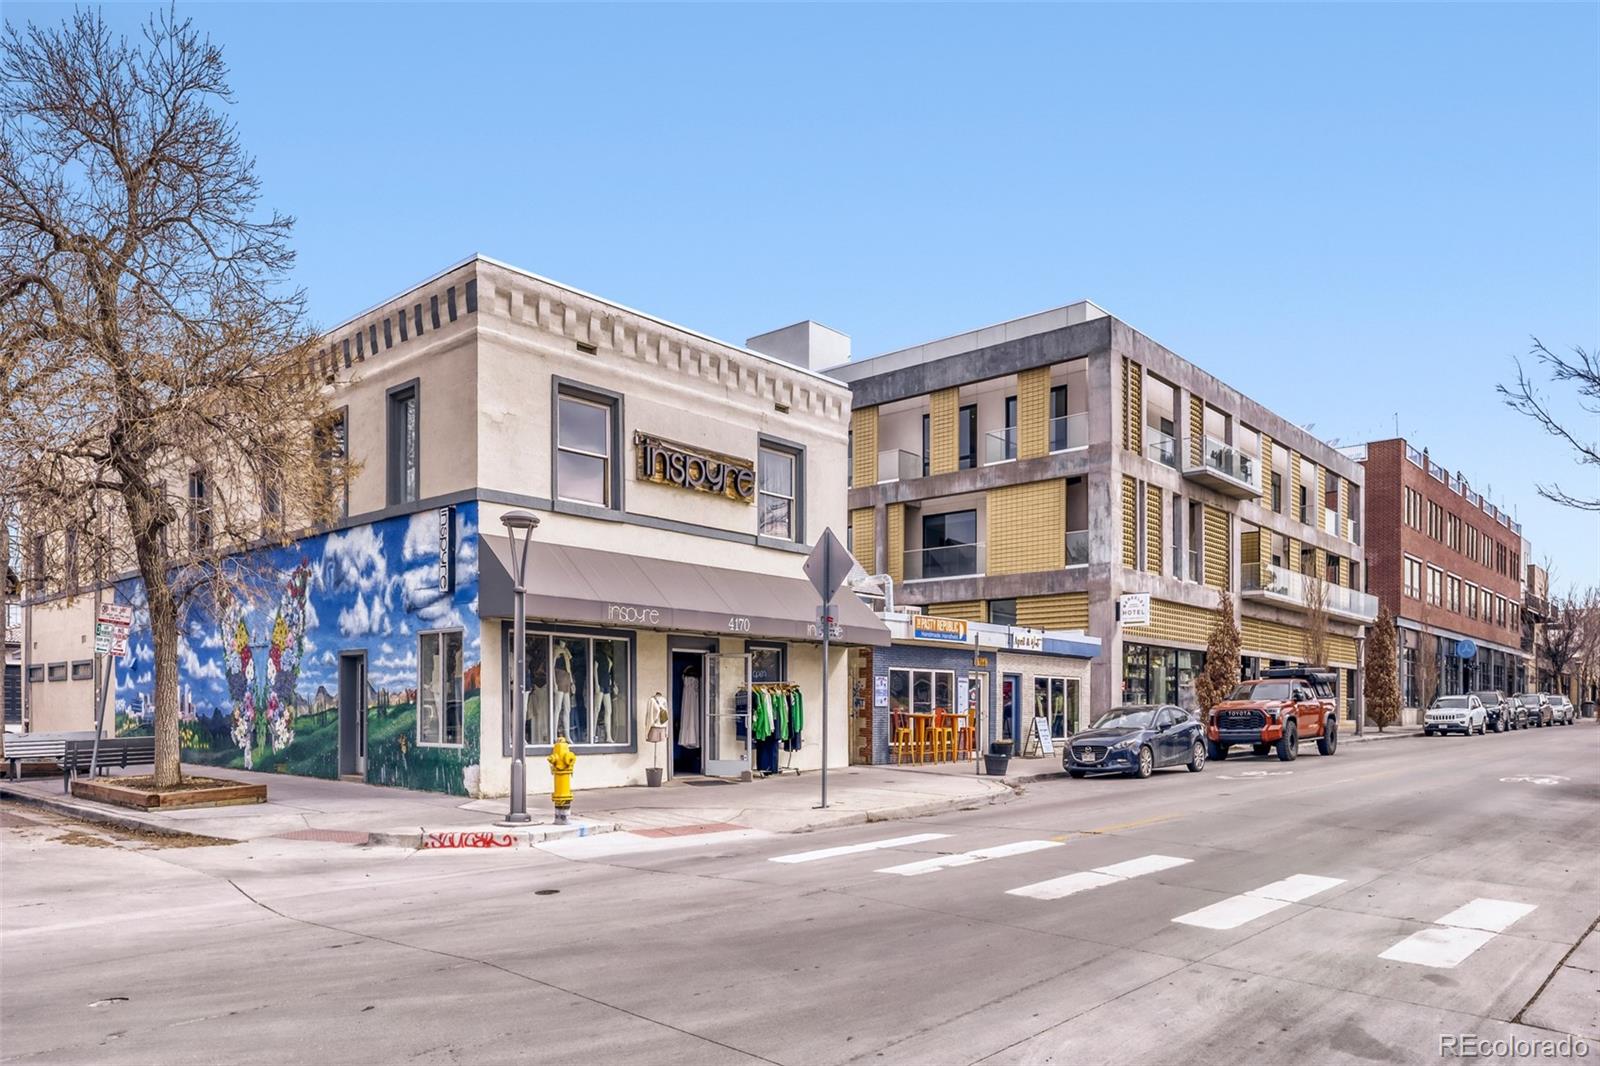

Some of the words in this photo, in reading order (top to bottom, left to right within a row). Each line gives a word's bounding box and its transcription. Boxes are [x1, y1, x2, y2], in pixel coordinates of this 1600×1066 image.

[440, 508, 448, 590] inspyre
[608, 604, 660, 625] inspyre
[728, 617, 751, 632] 4170
